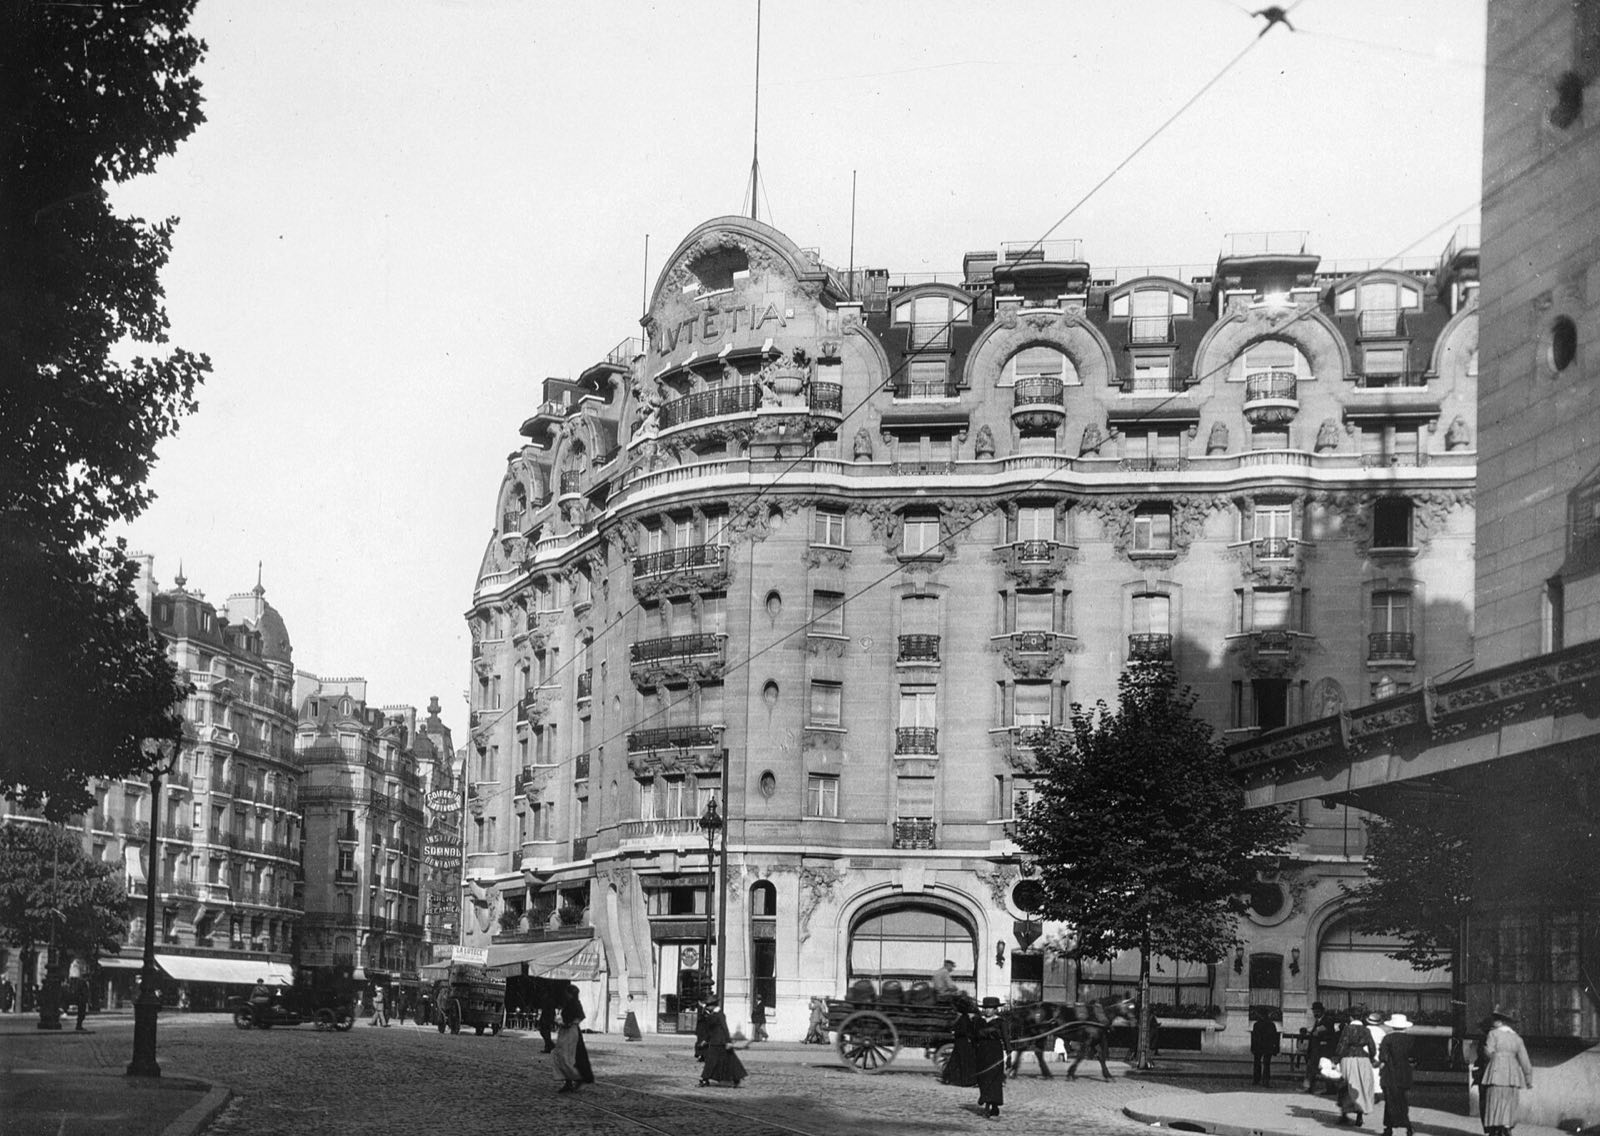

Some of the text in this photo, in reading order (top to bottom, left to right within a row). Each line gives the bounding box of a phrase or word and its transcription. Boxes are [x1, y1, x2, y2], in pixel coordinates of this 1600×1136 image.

[660, 302, 787, 357] LVTETIA
[425, 834, 462, 846] INSTITUT
[424, 856, 461, 869] DENTAIRE
